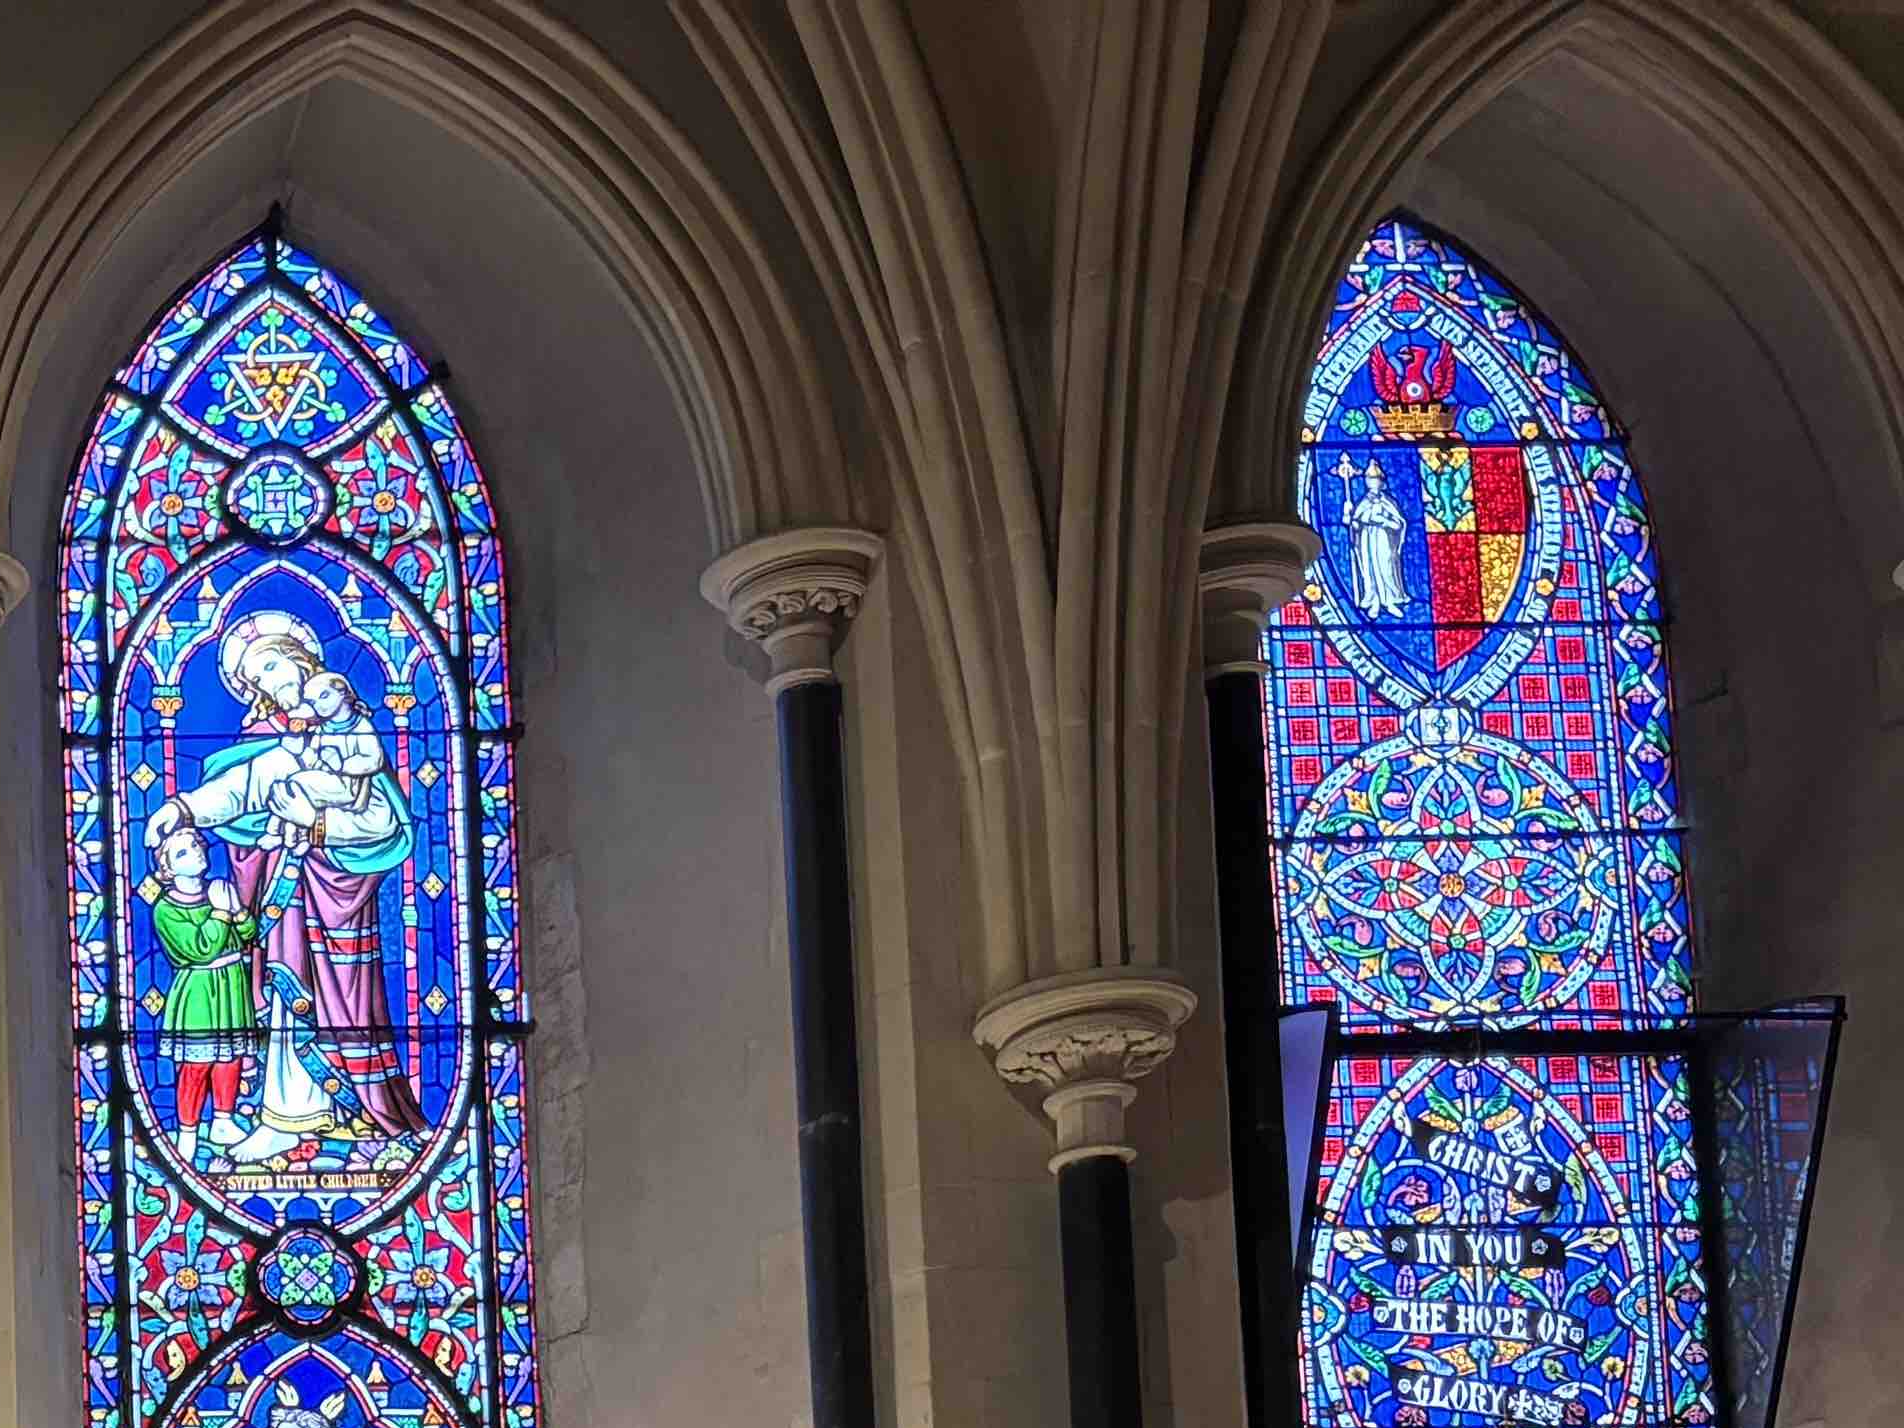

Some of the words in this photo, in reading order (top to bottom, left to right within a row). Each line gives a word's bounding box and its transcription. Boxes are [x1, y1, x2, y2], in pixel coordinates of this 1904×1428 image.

[275, 1173, 317, 1189] LITTLE
[1429, 1136, 1535, 1192] CHRIST
[1416, 1233, 1451, 1264] IN
[1465, 1234, 1521, 1264] YOU
[1387, 1300, 1447, 1333] THE
[1457, 1303, 1528, 1338] HOPE
[1537, 1311, 1572, 1345] OF
[1412, 1375, 1507, 1415] GLORY
